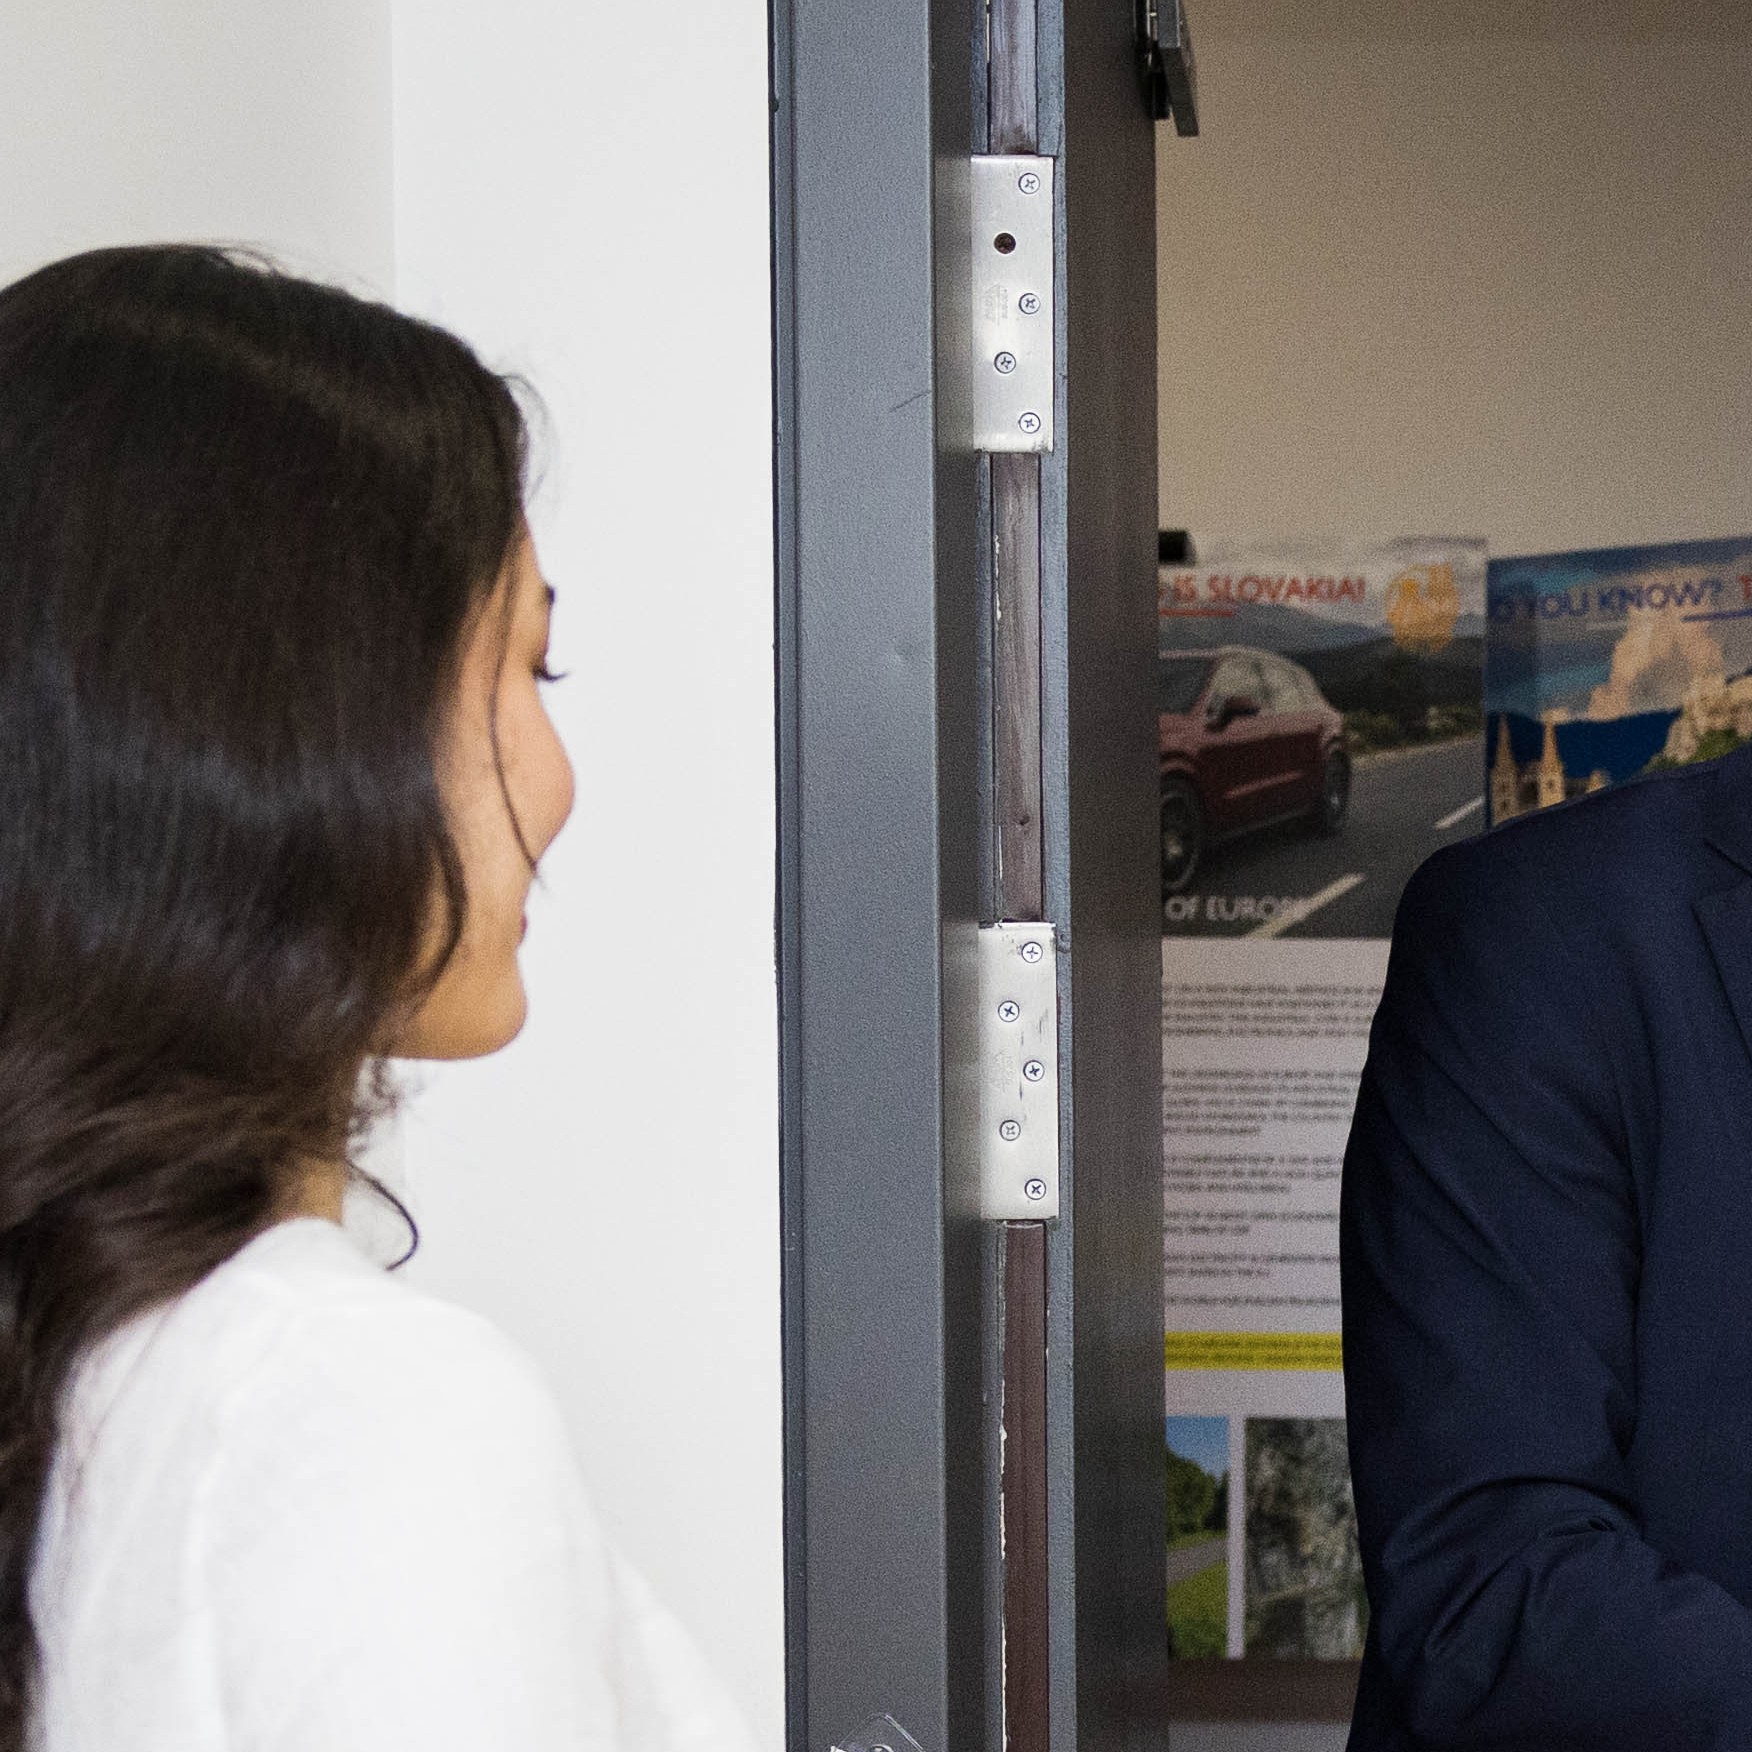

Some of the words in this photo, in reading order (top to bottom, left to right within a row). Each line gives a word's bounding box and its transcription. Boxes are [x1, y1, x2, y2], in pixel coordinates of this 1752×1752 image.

[1174, 575, 1197, 602] IS
[1207, 575, 1366, 603] SLOVAKIA!
[1599, 578, 1722, 614] KNOW?
